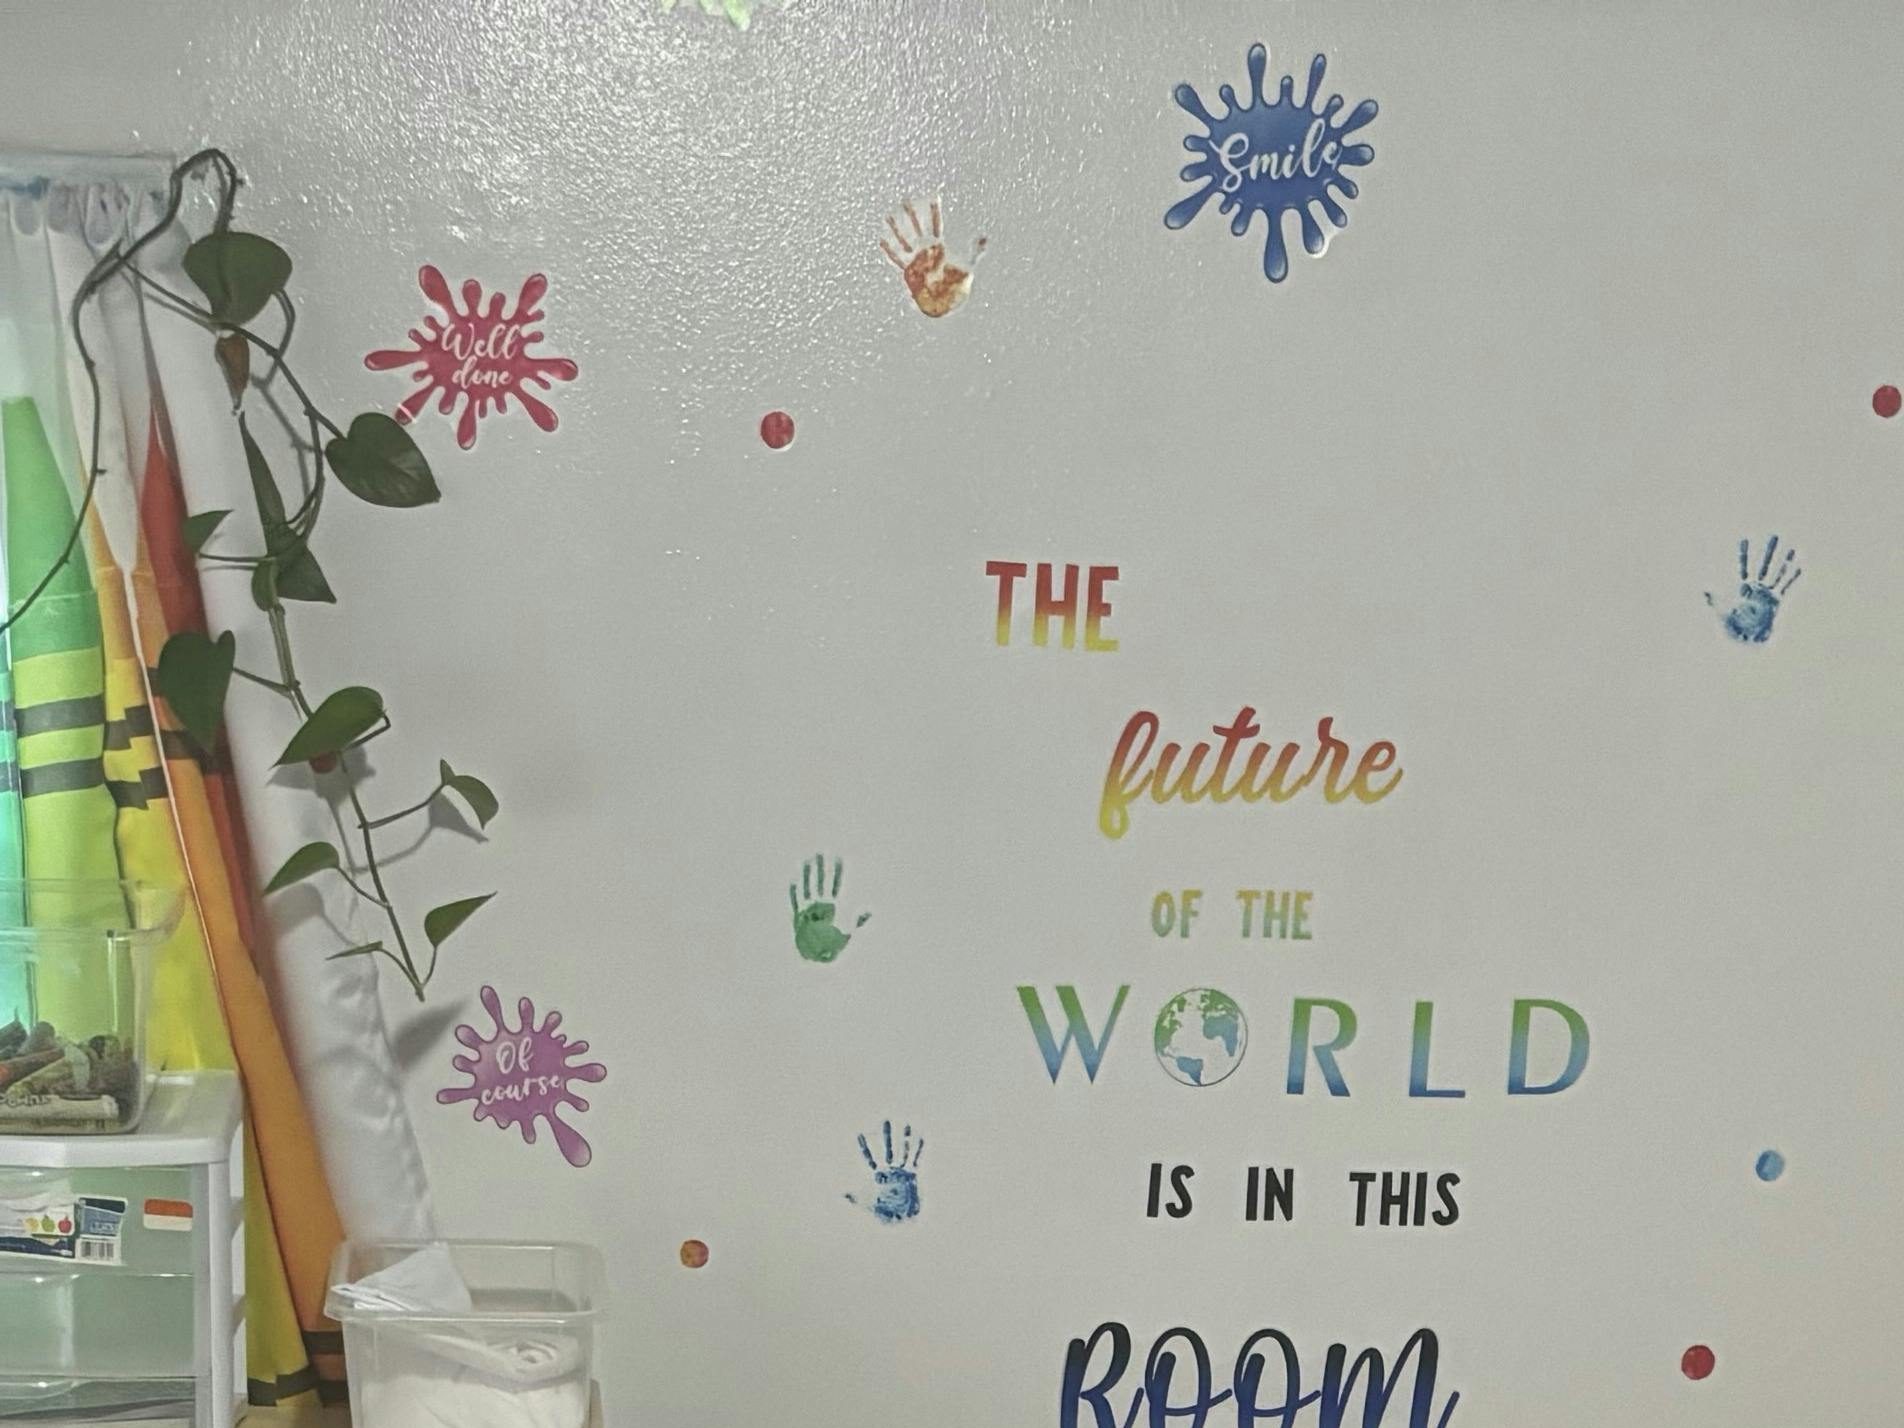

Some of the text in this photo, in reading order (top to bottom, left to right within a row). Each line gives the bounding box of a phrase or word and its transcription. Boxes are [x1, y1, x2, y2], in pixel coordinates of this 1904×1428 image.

[1210, 118, 1343, 194] Smile
[441, 322, 521, 361] Well
[451, 355, 513, 389] done
[986, 559, 1120, 653] THE
[1097, 706, 1404, 840] future
[1151, 890, 1314, 941] OF THE
[495, 1036, 535, 1075] Of
[480, 1074, 566, 1107] course
[1145, 1162, 1462, 1227] IS IN THIS
